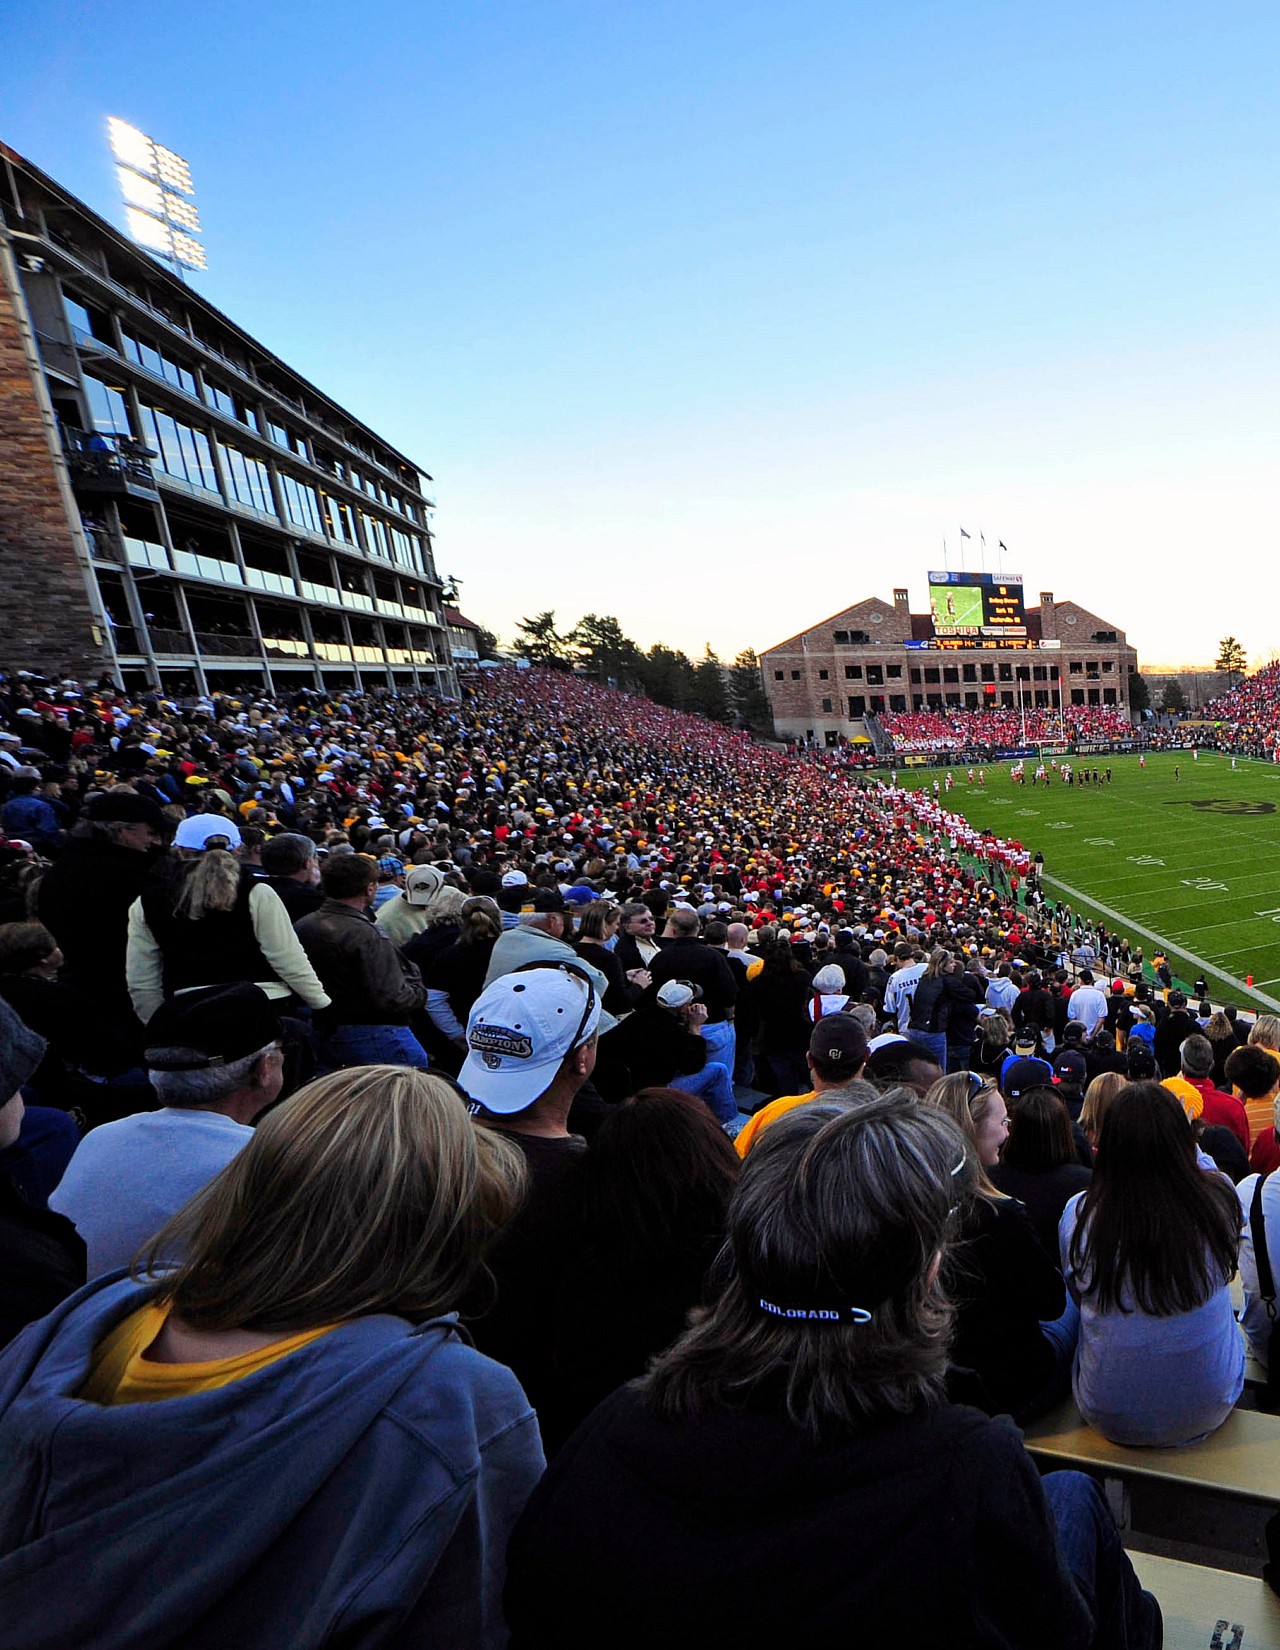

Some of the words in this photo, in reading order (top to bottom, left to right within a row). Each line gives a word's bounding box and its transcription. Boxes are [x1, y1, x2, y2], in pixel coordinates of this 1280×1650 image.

[1181, 876, 1225, 891] 20
[829, 1048, 842, 1060] CU
[760, 1299, 840, 1320] COLORADO
